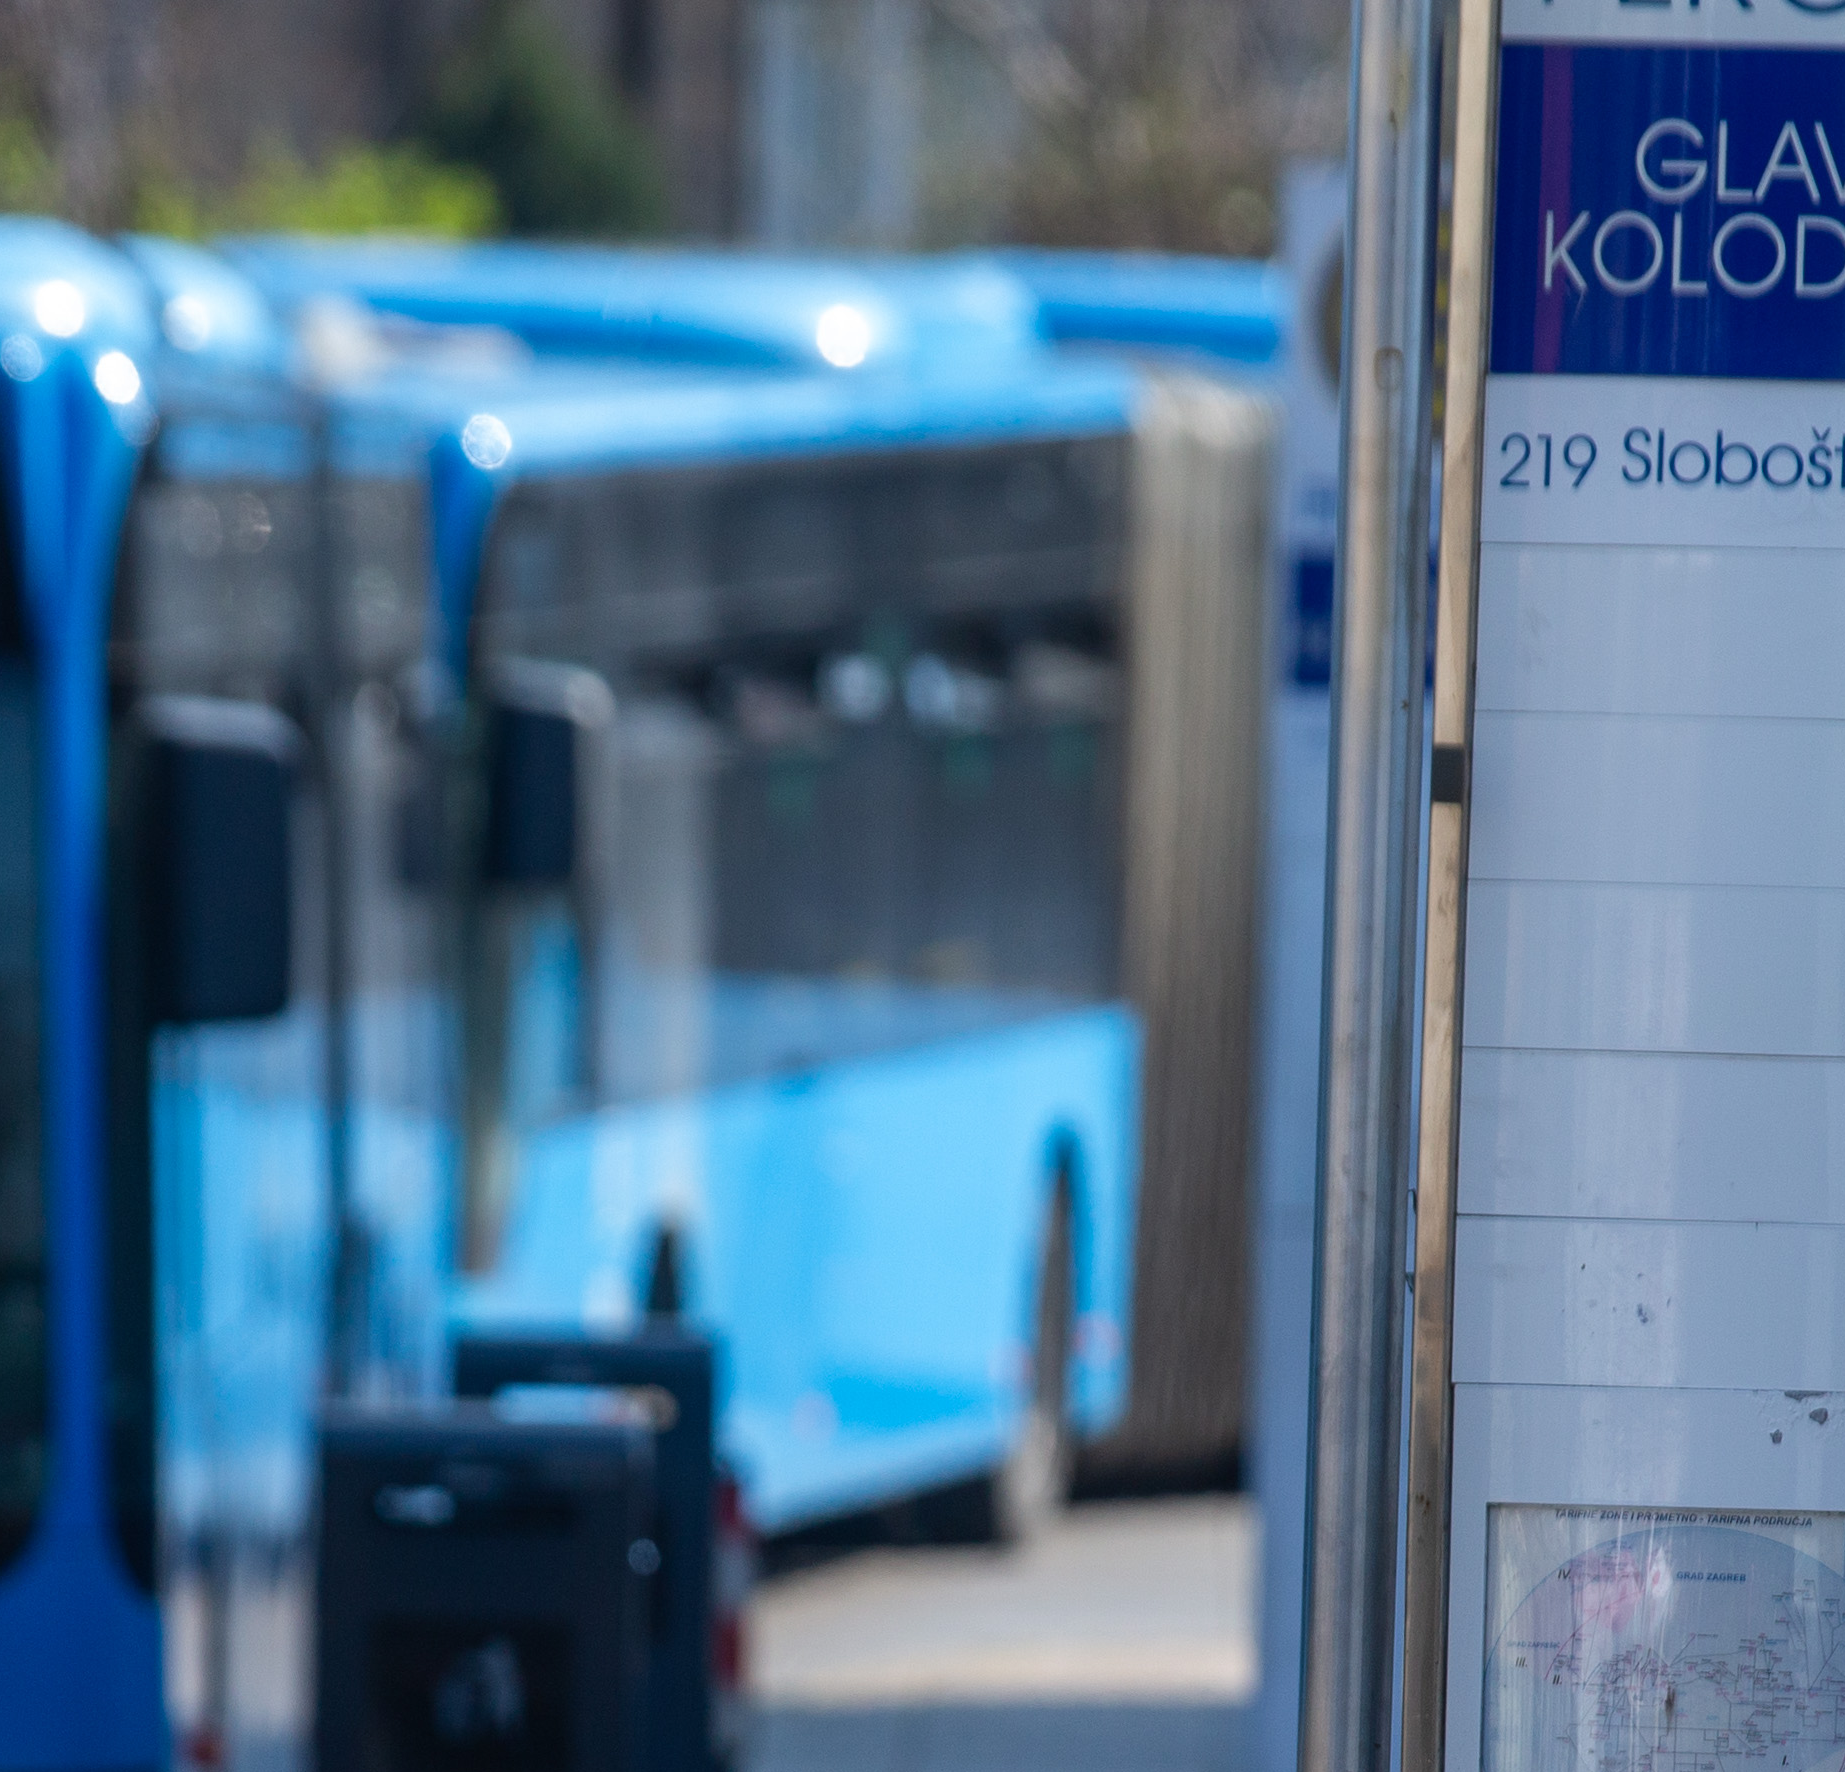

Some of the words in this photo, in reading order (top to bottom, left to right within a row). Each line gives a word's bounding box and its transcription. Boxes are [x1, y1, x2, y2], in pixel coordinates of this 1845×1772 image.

[1499, 431, 1598, 491] 219
[1600, 1510, 1629, 1521] ZONE
[1637, 1512, 1697, 1524] PROMETNO
[1706, 1514, 1752, 1526] TARIFNA
[1676, 1571, 1704, 1581] GRAD
[1706, 1572, 1747, 1582] ZAGREB
